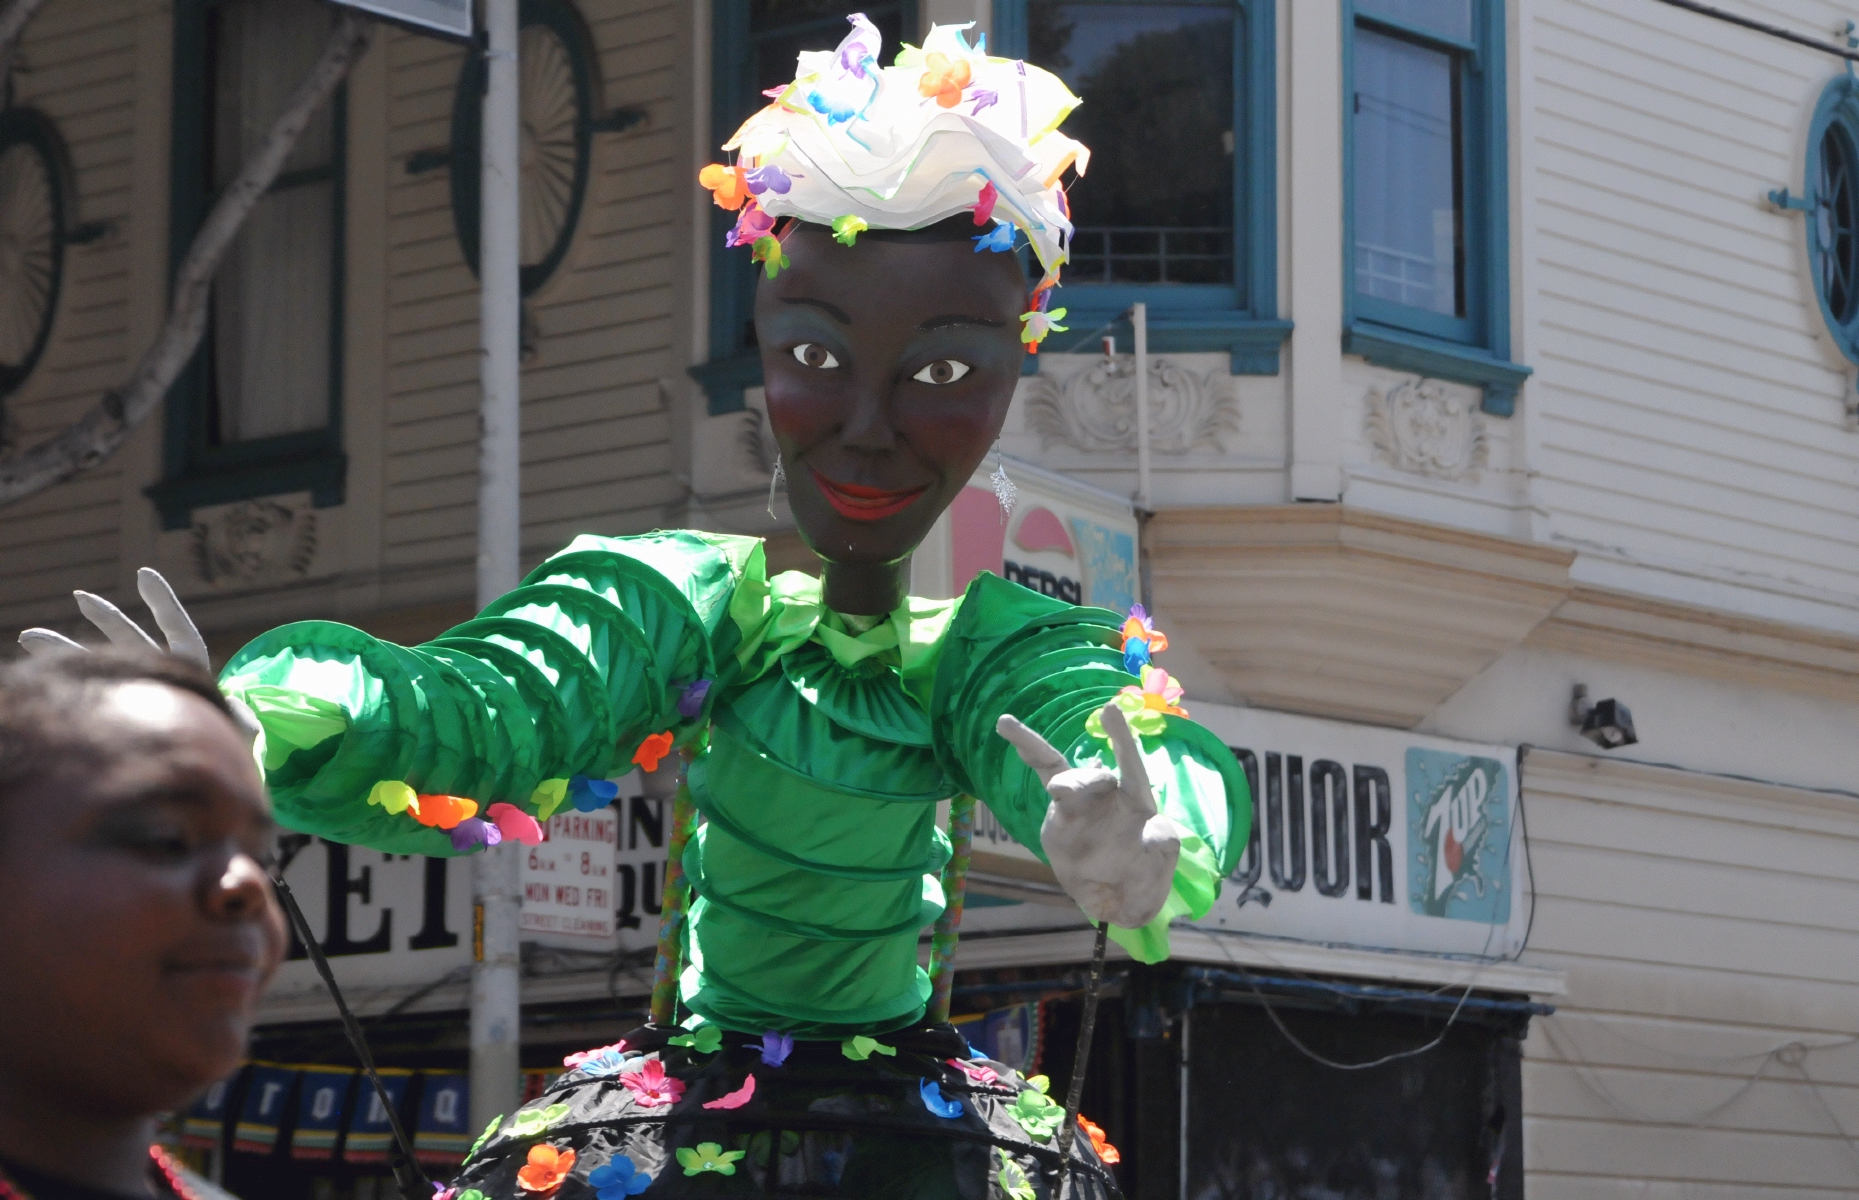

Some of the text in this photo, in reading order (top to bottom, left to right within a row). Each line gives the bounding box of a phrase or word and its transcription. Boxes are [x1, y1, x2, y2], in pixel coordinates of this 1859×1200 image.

[553, 814, 615, 843] PARKING
[1424, 767, 1487, 900] 7UP
[525, 882, 607, 909] MON WED FRI
